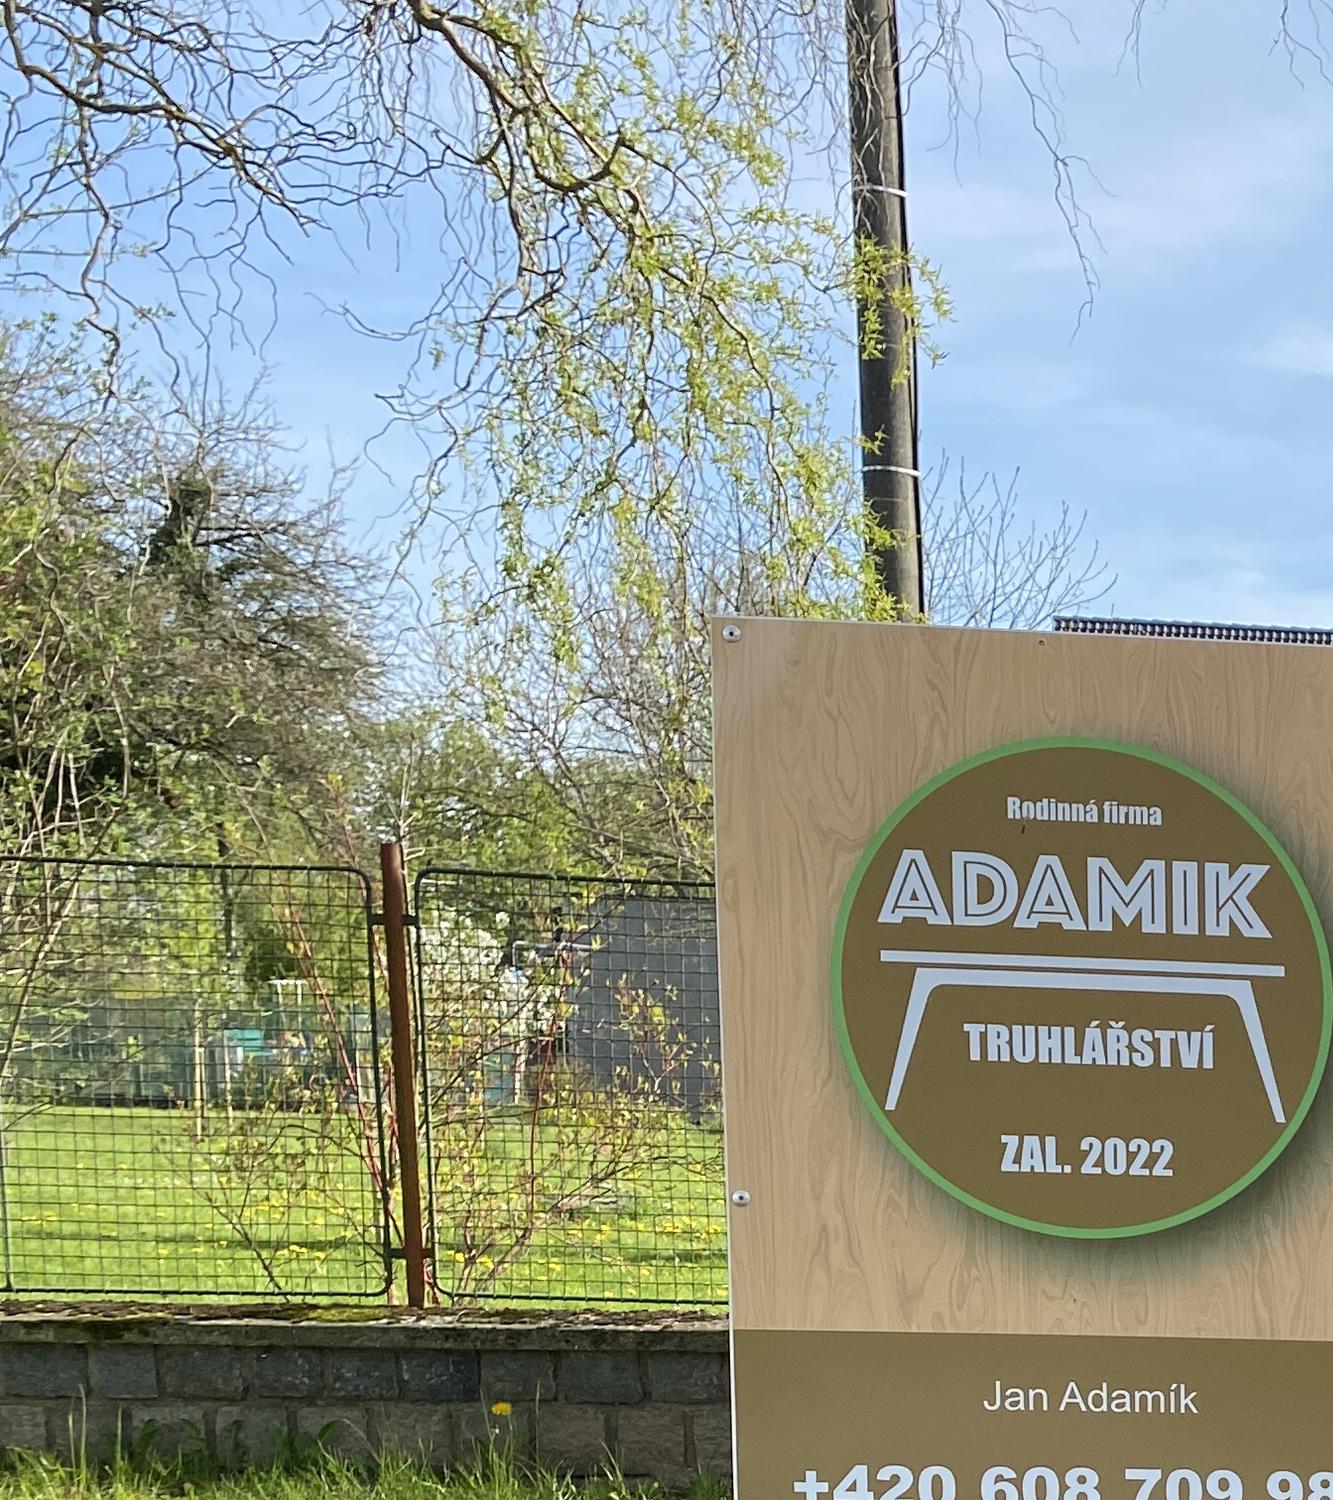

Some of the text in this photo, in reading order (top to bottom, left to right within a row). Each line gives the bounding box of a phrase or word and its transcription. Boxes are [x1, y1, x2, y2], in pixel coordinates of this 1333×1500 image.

[1006, 796, 1163, 826] Rodinná firma
[877, 848, 1273, 939] ADAMIK
[963, 1020, 1215, 1069] TRUHLÁŘSTVÍ
[1000, 1134, 1174, 1177] ZAL. 2022
[983, 1380, 1199, 1414] Jan Adamík
